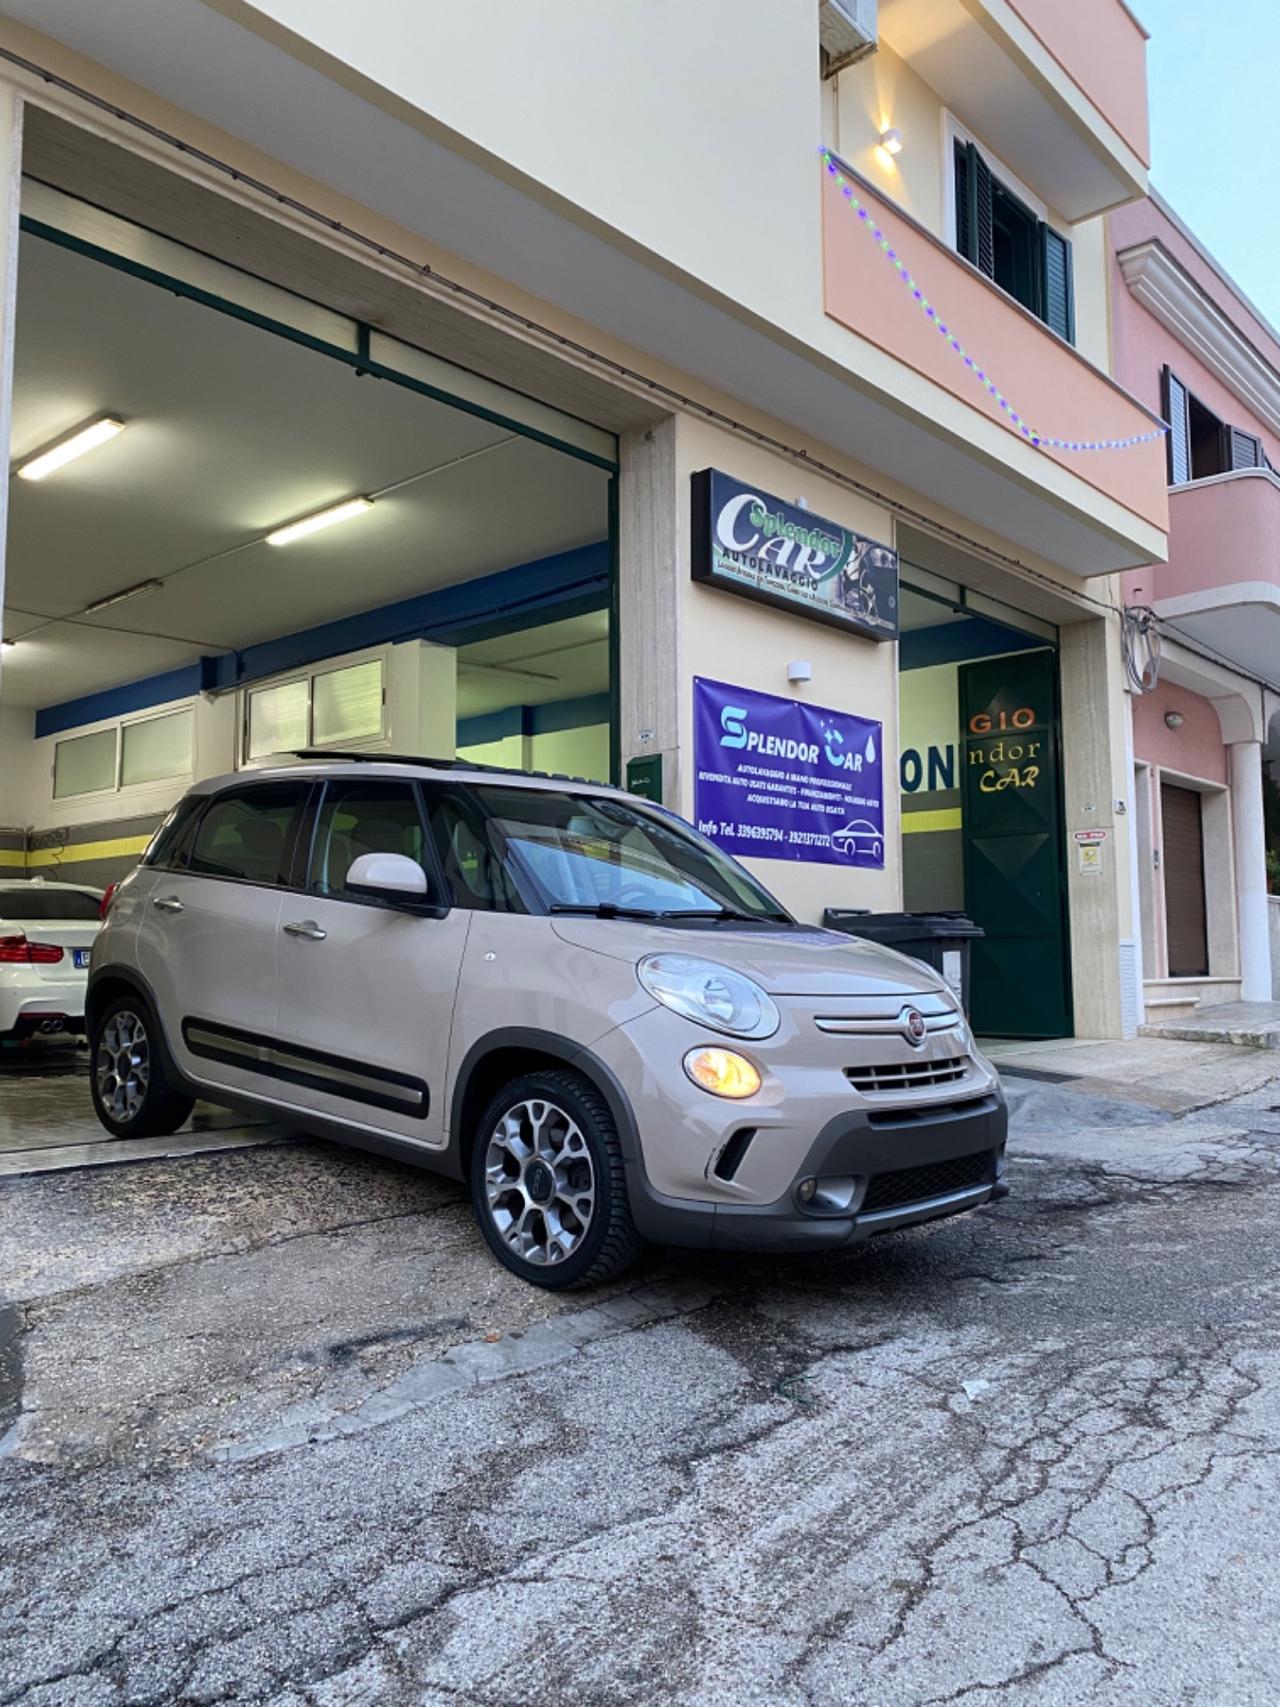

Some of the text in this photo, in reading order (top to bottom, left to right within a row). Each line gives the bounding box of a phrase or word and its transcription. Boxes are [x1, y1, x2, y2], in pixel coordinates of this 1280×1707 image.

[716, 494, 826, 580] CAR
[749, 502, 842, 559] Splendor
[722, 547, 819, 592] AUTOLAVAGGIO
[969, 707, 1036, 734] GIO
[720, 705, 863, 773] SPLENDOR CAR
[969, 741, 1041, 764] ndor
[732, 776, 748, 788] AUTO
[736, 764, 785, 780] AUTOLAVAGGIO
[900, 744, 954, 793] ON
[979, 764, 1041, 793] CAR
[810, 803, 825, 813] AUTO
[825, 806, 846, 816] USATA
[698, 820, 718, 837] Info
